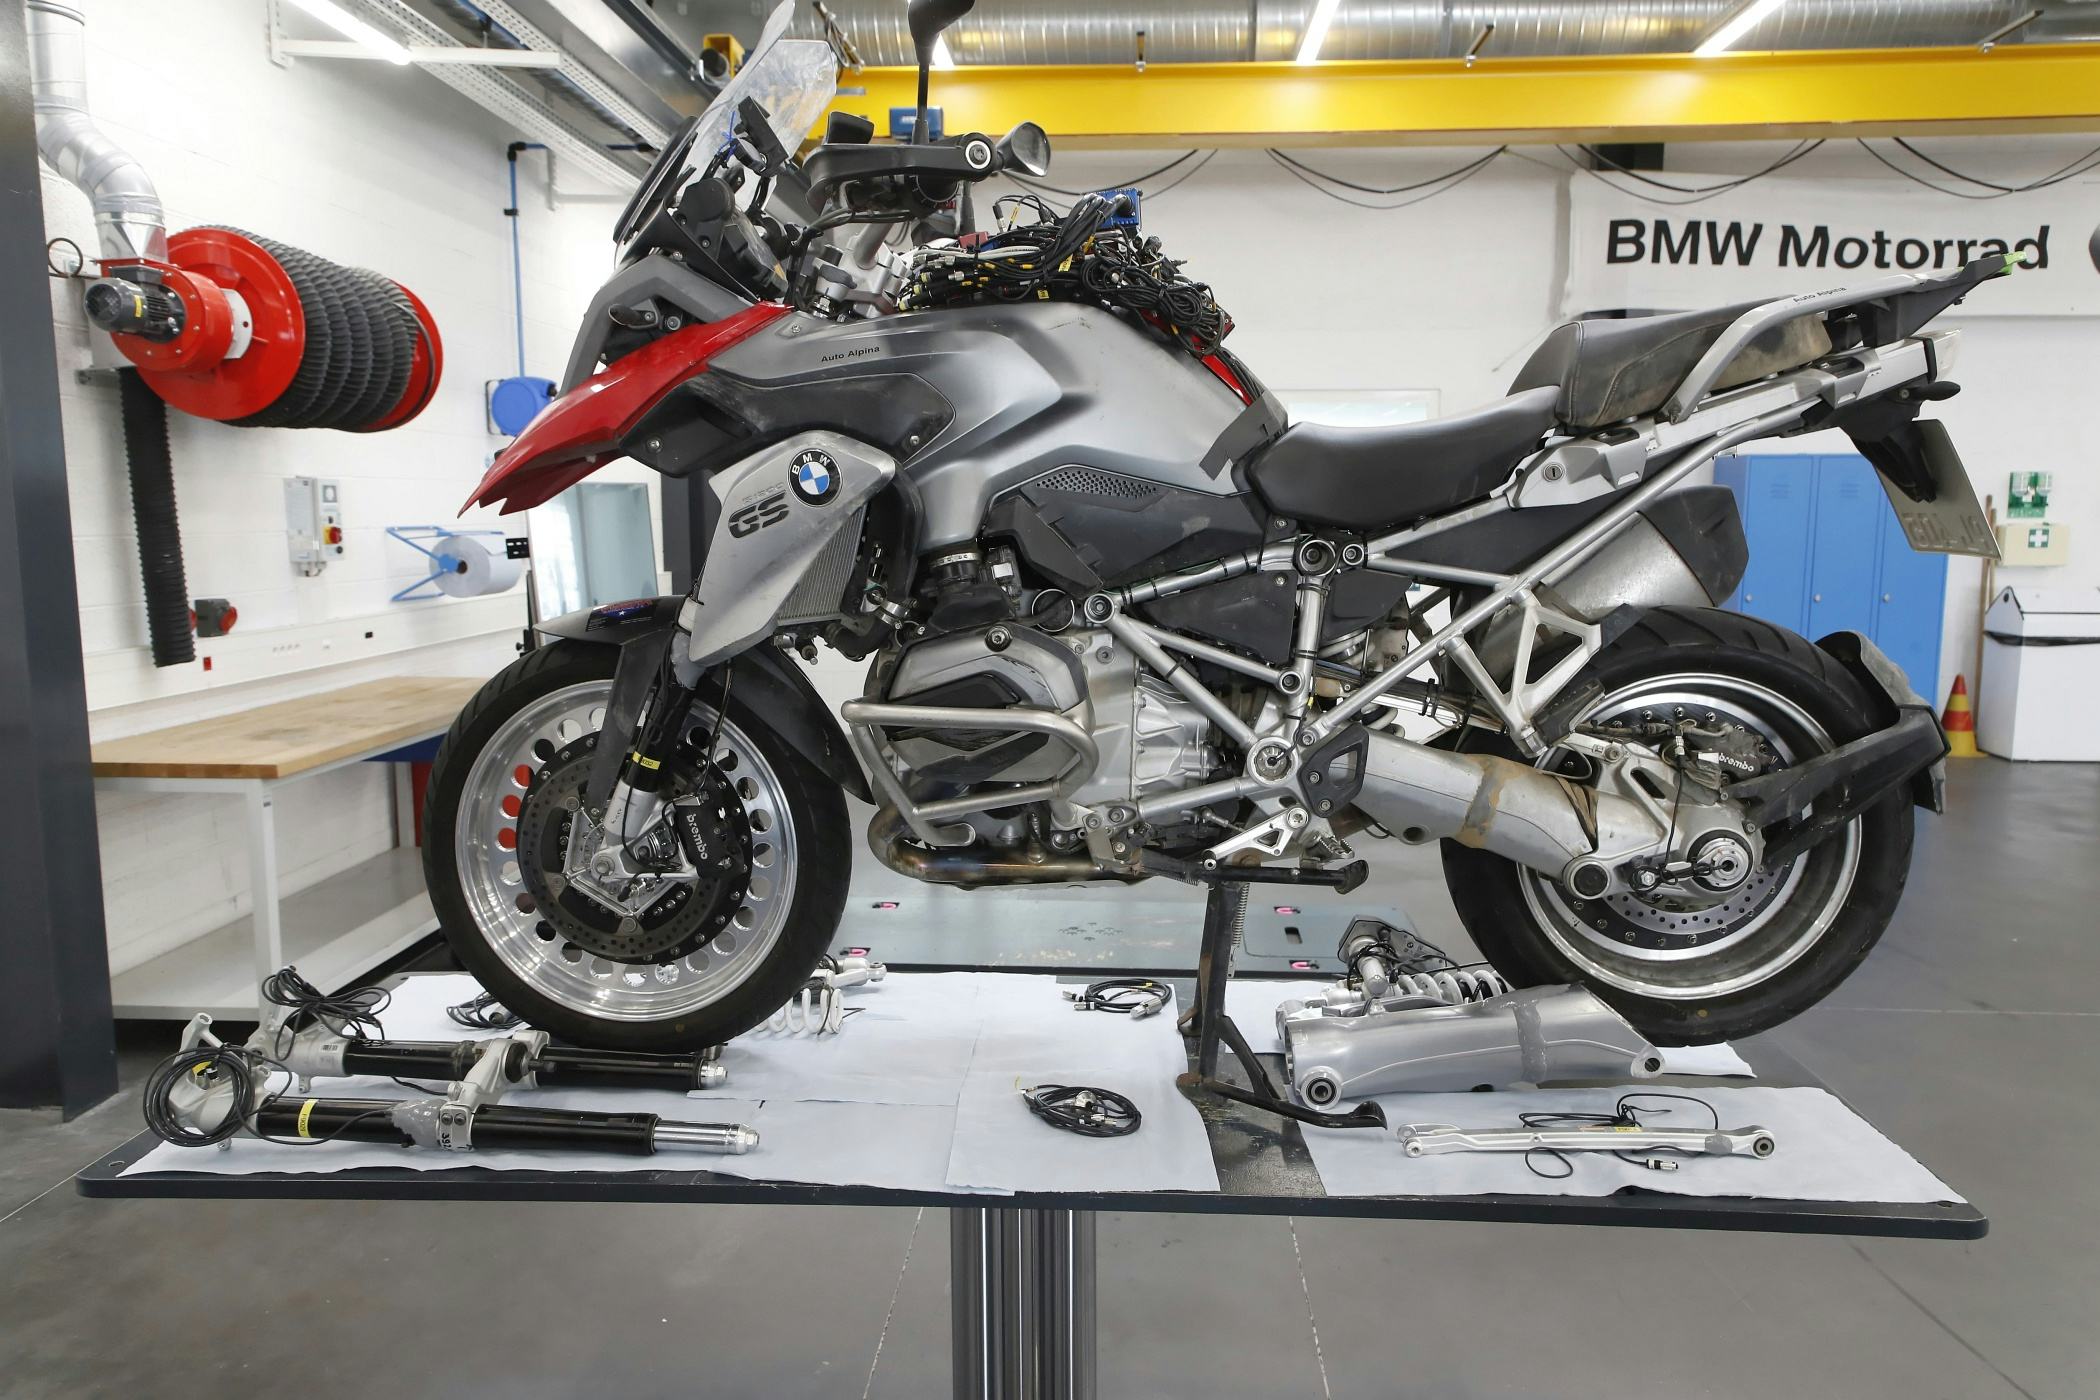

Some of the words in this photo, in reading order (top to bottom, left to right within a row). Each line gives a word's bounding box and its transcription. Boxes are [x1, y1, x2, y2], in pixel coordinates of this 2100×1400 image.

[1607, 219, 1763, 266] BMW
[1778, 225, 2050, 270] Motorrad
[1793, 294, 1816, 303] Auto
[1816, 287, 1847, 296] Alpina
[821, 353, 845, 363] Auto
[847, 346, 880, 357] Alpina
[791, 452, 831, 475] BMW
[728, 490, 790, 539] GS
[1718, 752, 1755, 772] brembo
[686, 813, 708, 860] brembo
